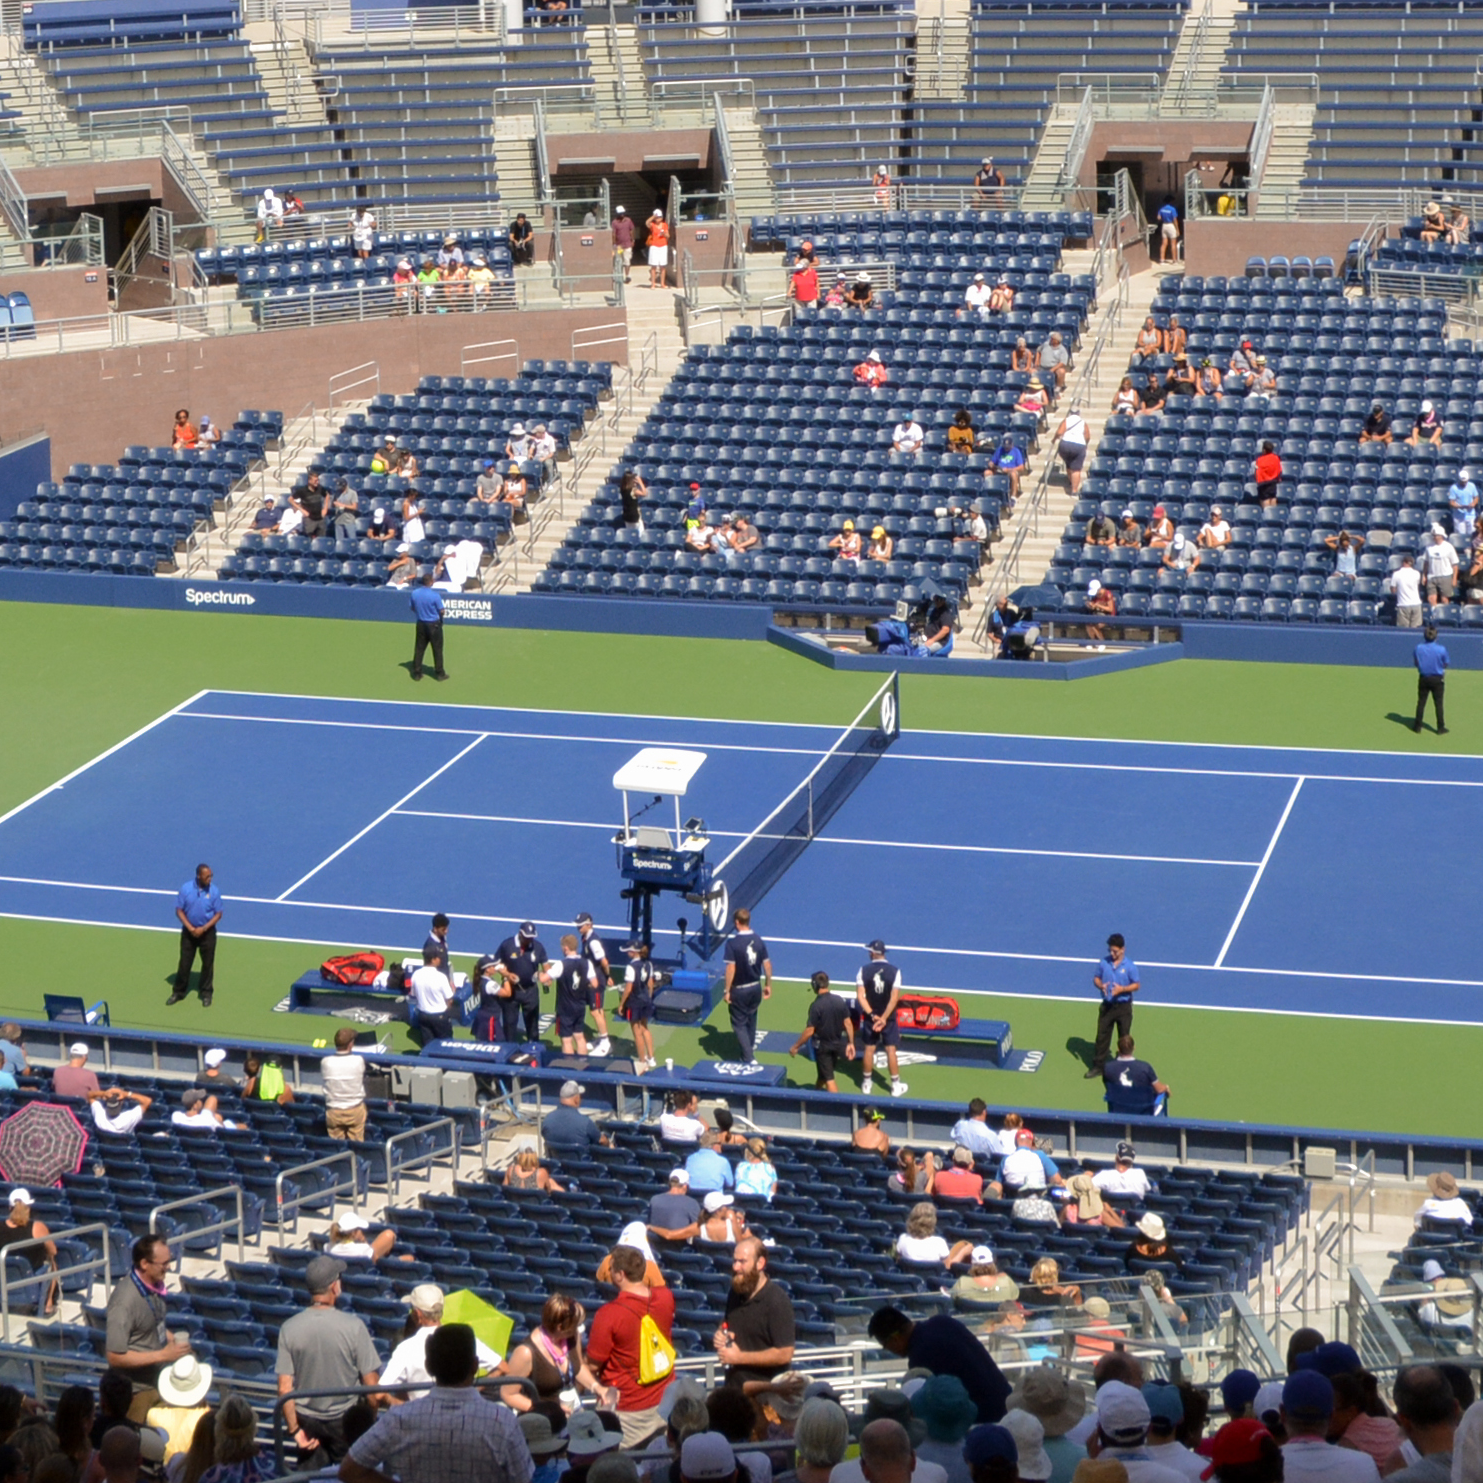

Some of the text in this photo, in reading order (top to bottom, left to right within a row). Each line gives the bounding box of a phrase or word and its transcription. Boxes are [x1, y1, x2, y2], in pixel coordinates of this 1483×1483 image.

[185, 588, 250, 606] Spectrum
[442, 599, 492, 610] MERICAN
[633, 858, 669, 870] Spectrum
[441, 1040, 501, 1053] Wilson
[1019, 1051, 1044, 1072] POLO
[714, 1062, 764, 1074] evian
